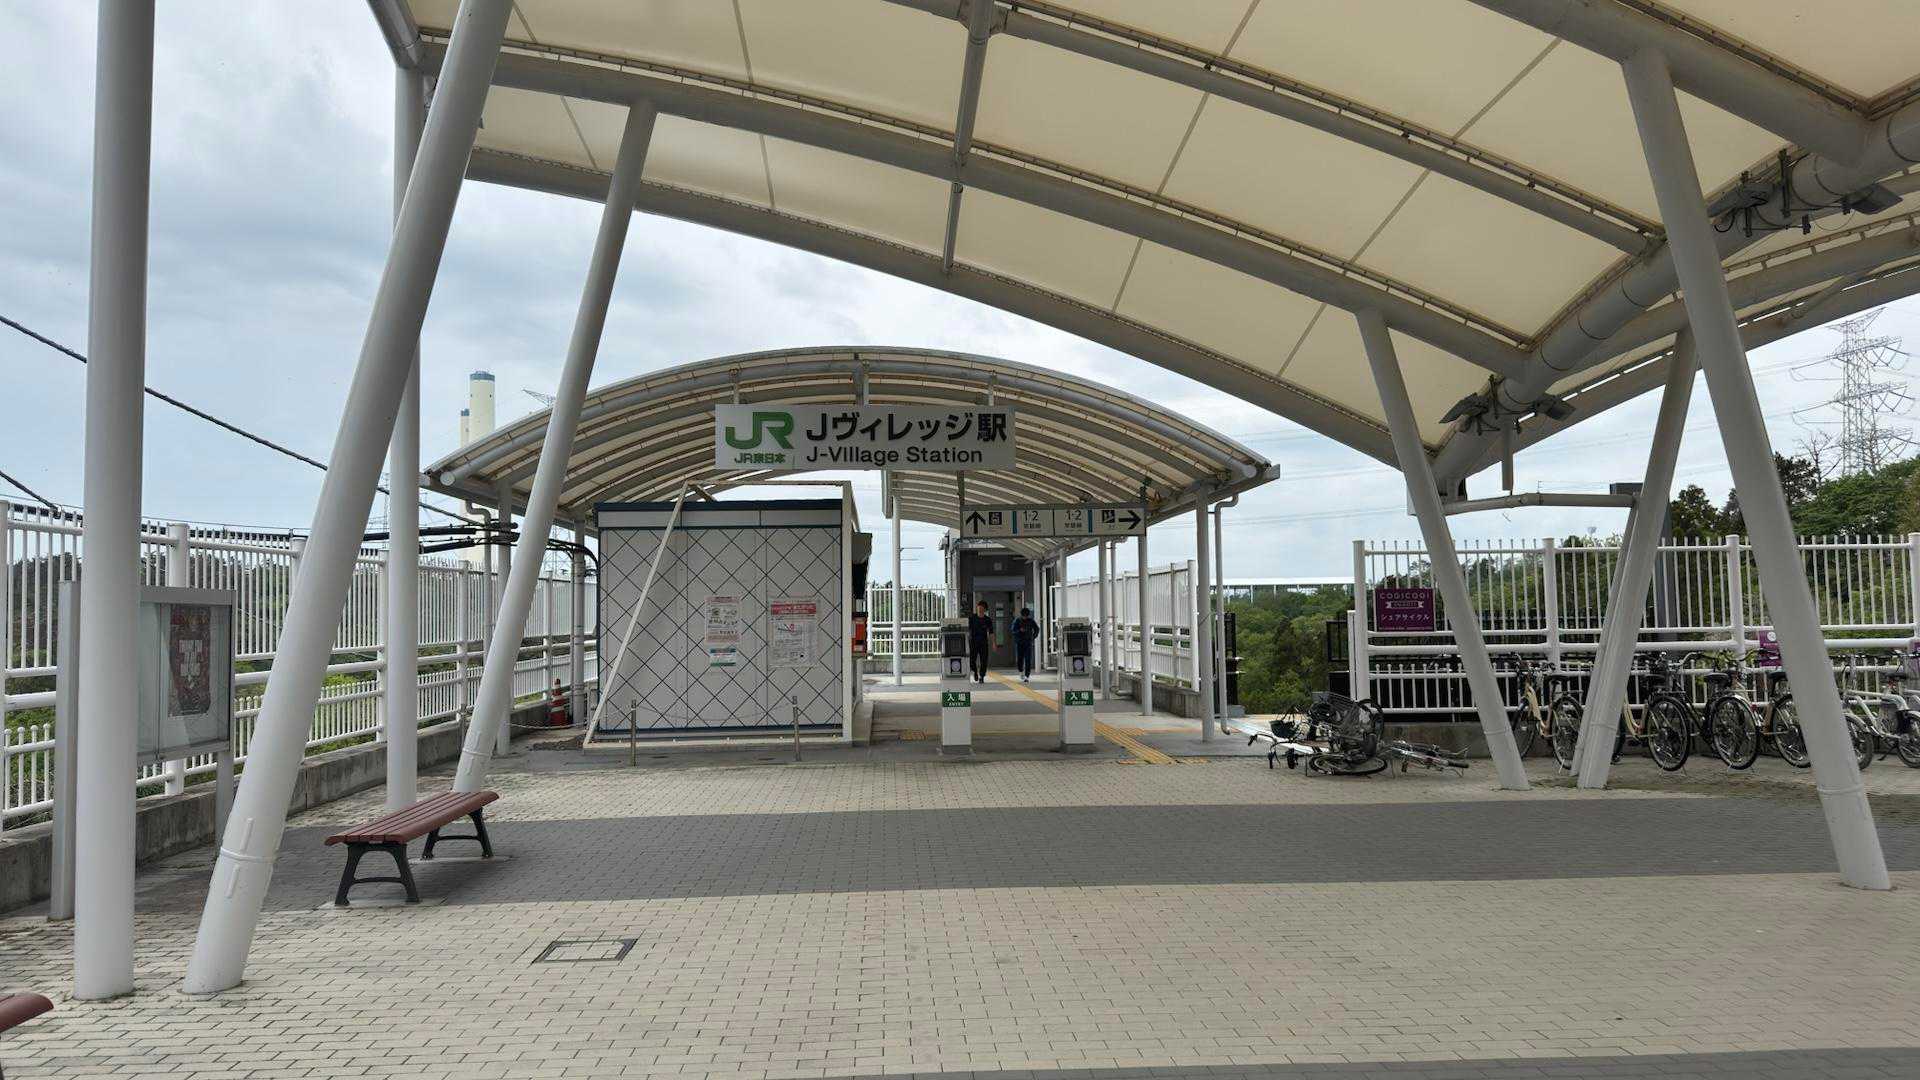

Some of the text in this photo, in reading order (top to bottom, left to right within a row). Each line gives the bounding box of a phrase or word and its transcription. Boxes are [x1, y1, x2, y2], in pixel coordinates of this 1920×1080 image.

[725, 411, 794, 450] JR
[806, 412, 1007, 442] Jヴィレッジ駅
[734, 453, 786, 464] JR東日本
[806, 446, 983, 466] J-Village Station
[946, 692, 966, 702] 入場
[1070, 691, 1089, 701] 入場
